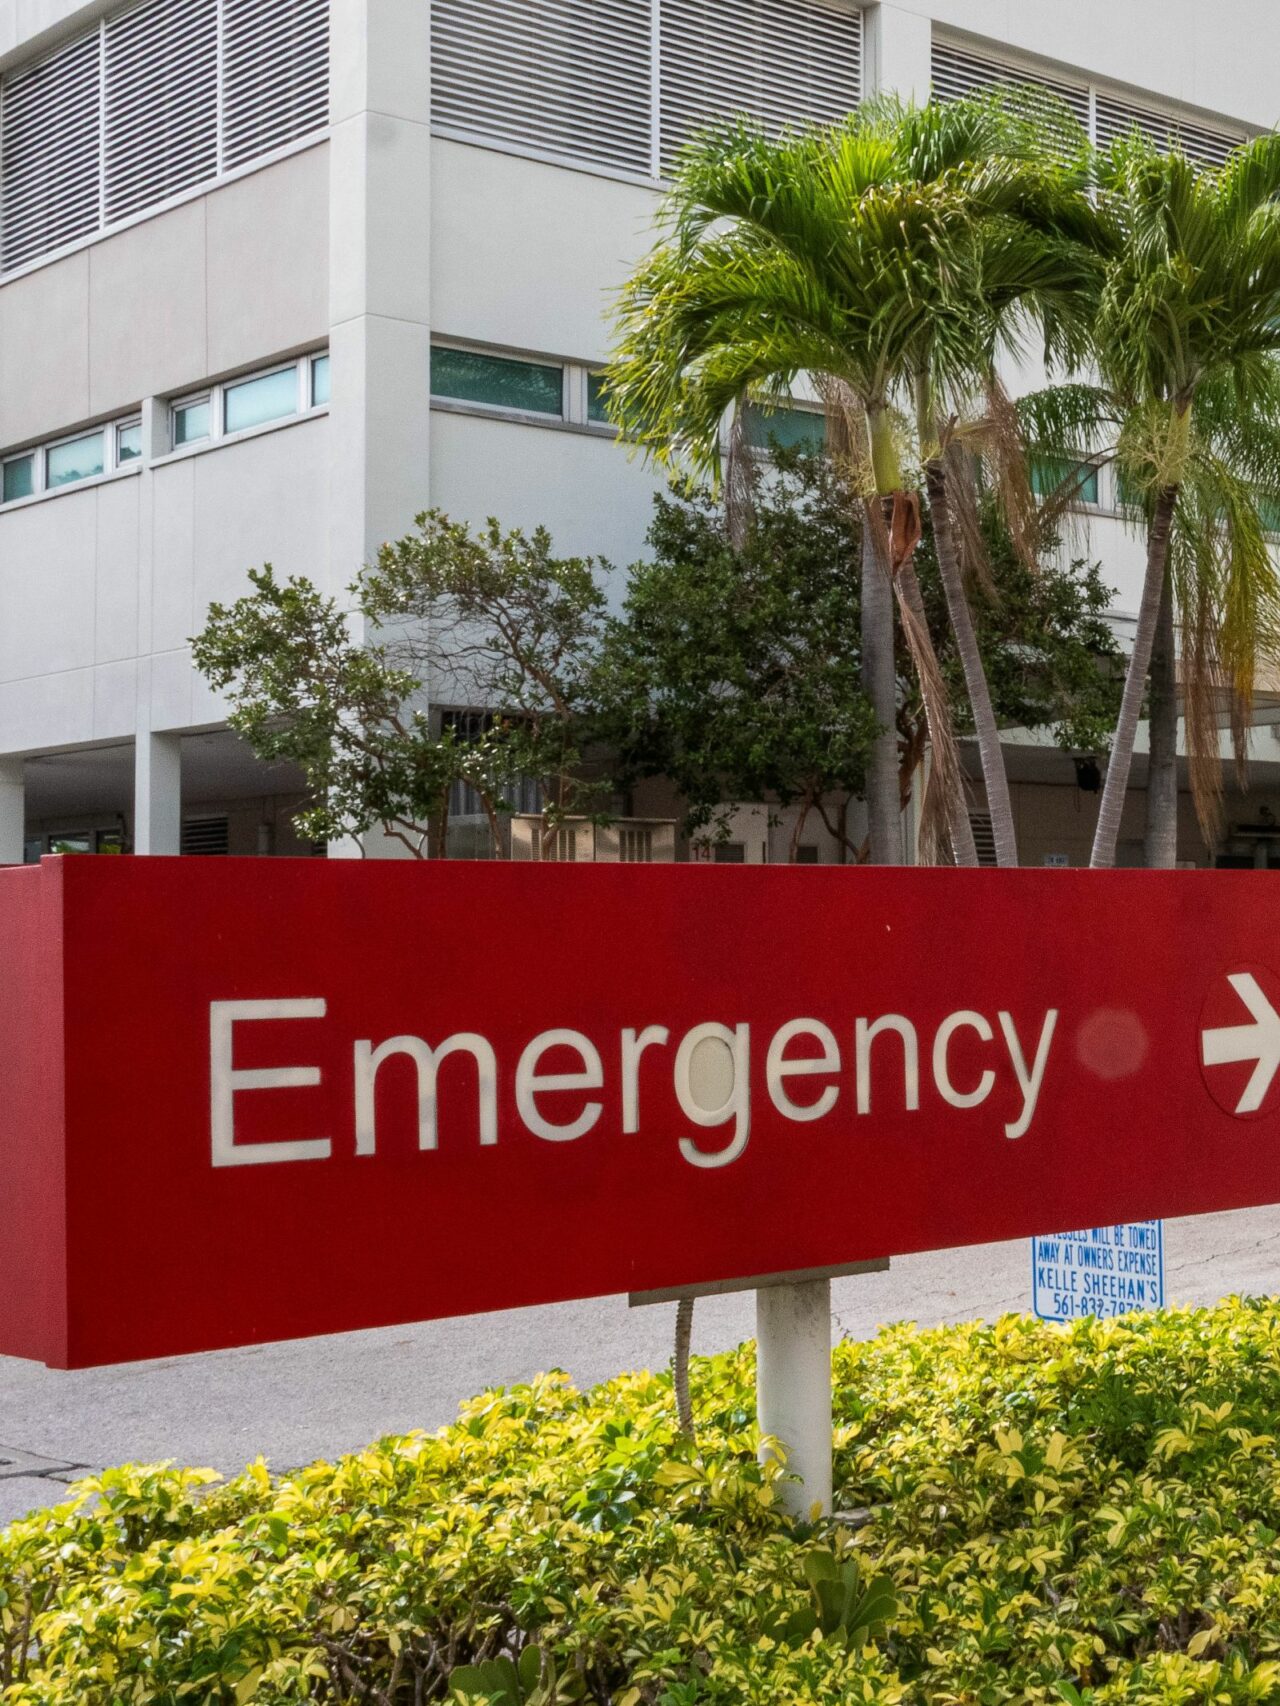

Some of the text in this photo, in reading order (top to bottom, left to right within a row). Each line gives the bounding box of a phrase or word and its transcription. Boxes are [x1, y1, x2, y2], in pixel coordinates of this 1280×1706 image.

[209, 997, 1060, 1169] Emergency
[1092, 1227, 1110, 1245] WILL
[1114, 1225, 1125, 1247] BE
[1128, 1226, 1156, 1250] TOWED
[1038, 1241, 1157, 1276] AWAY AT OWNERS EXPENSE
[1038, 1266, 1157, 1303] KELLE SHEEHAN'S
